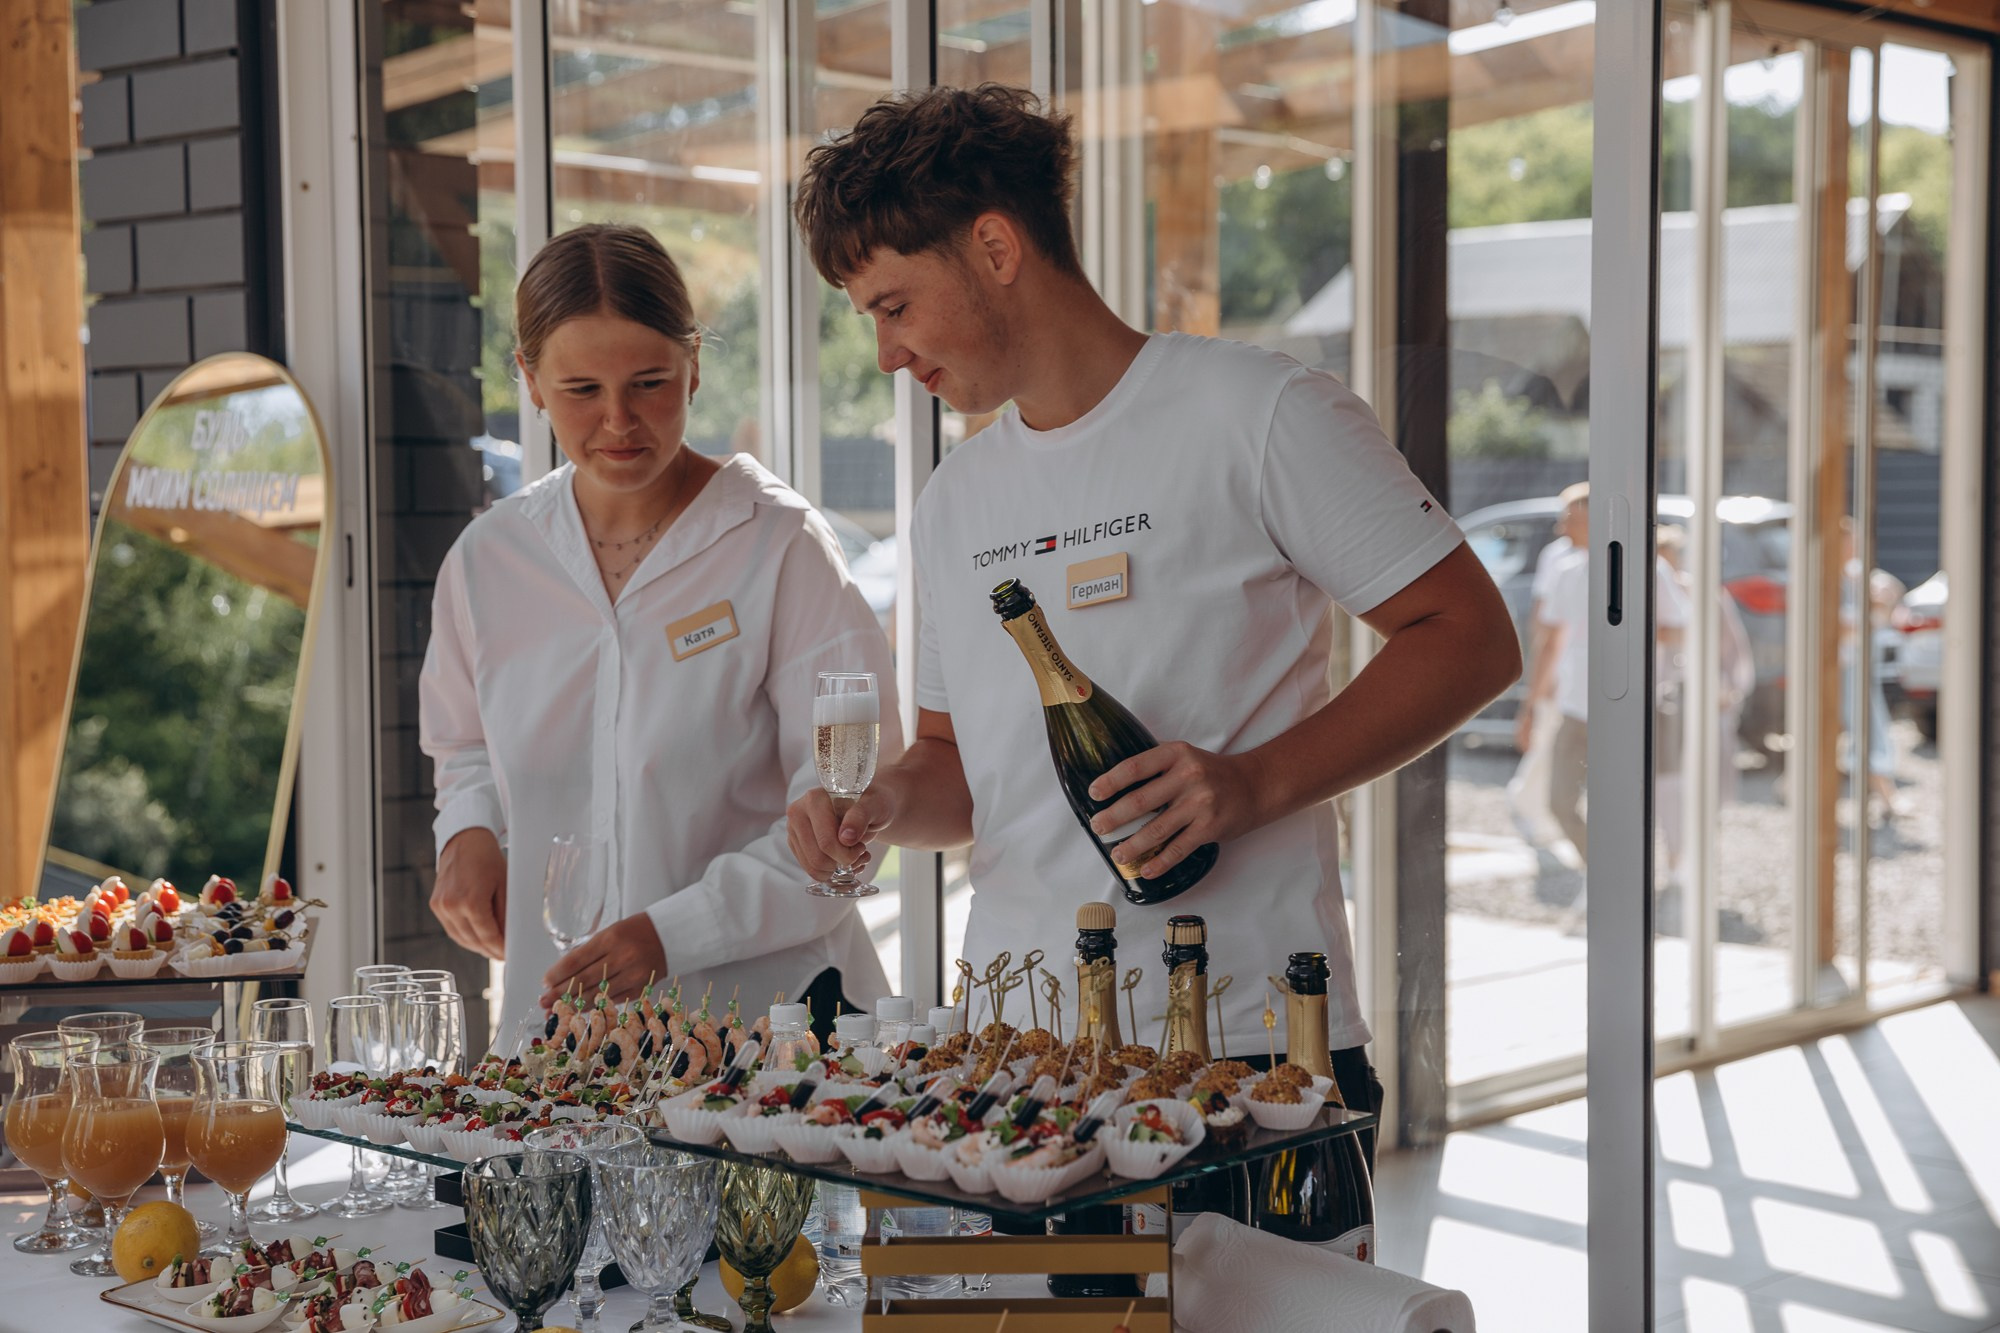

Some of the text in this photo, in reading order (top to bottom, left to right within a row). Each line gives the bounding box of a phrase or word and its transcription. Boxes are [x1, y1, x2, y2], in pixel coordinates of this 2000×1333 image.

[972, 513, 1152, 571] TOMMY HILFIGER
[1072, 577, 1119, 600] Герман
[683, 626, 716, 647] Катя
[1028, 613, 1074, 682] SANTO STEFANO
